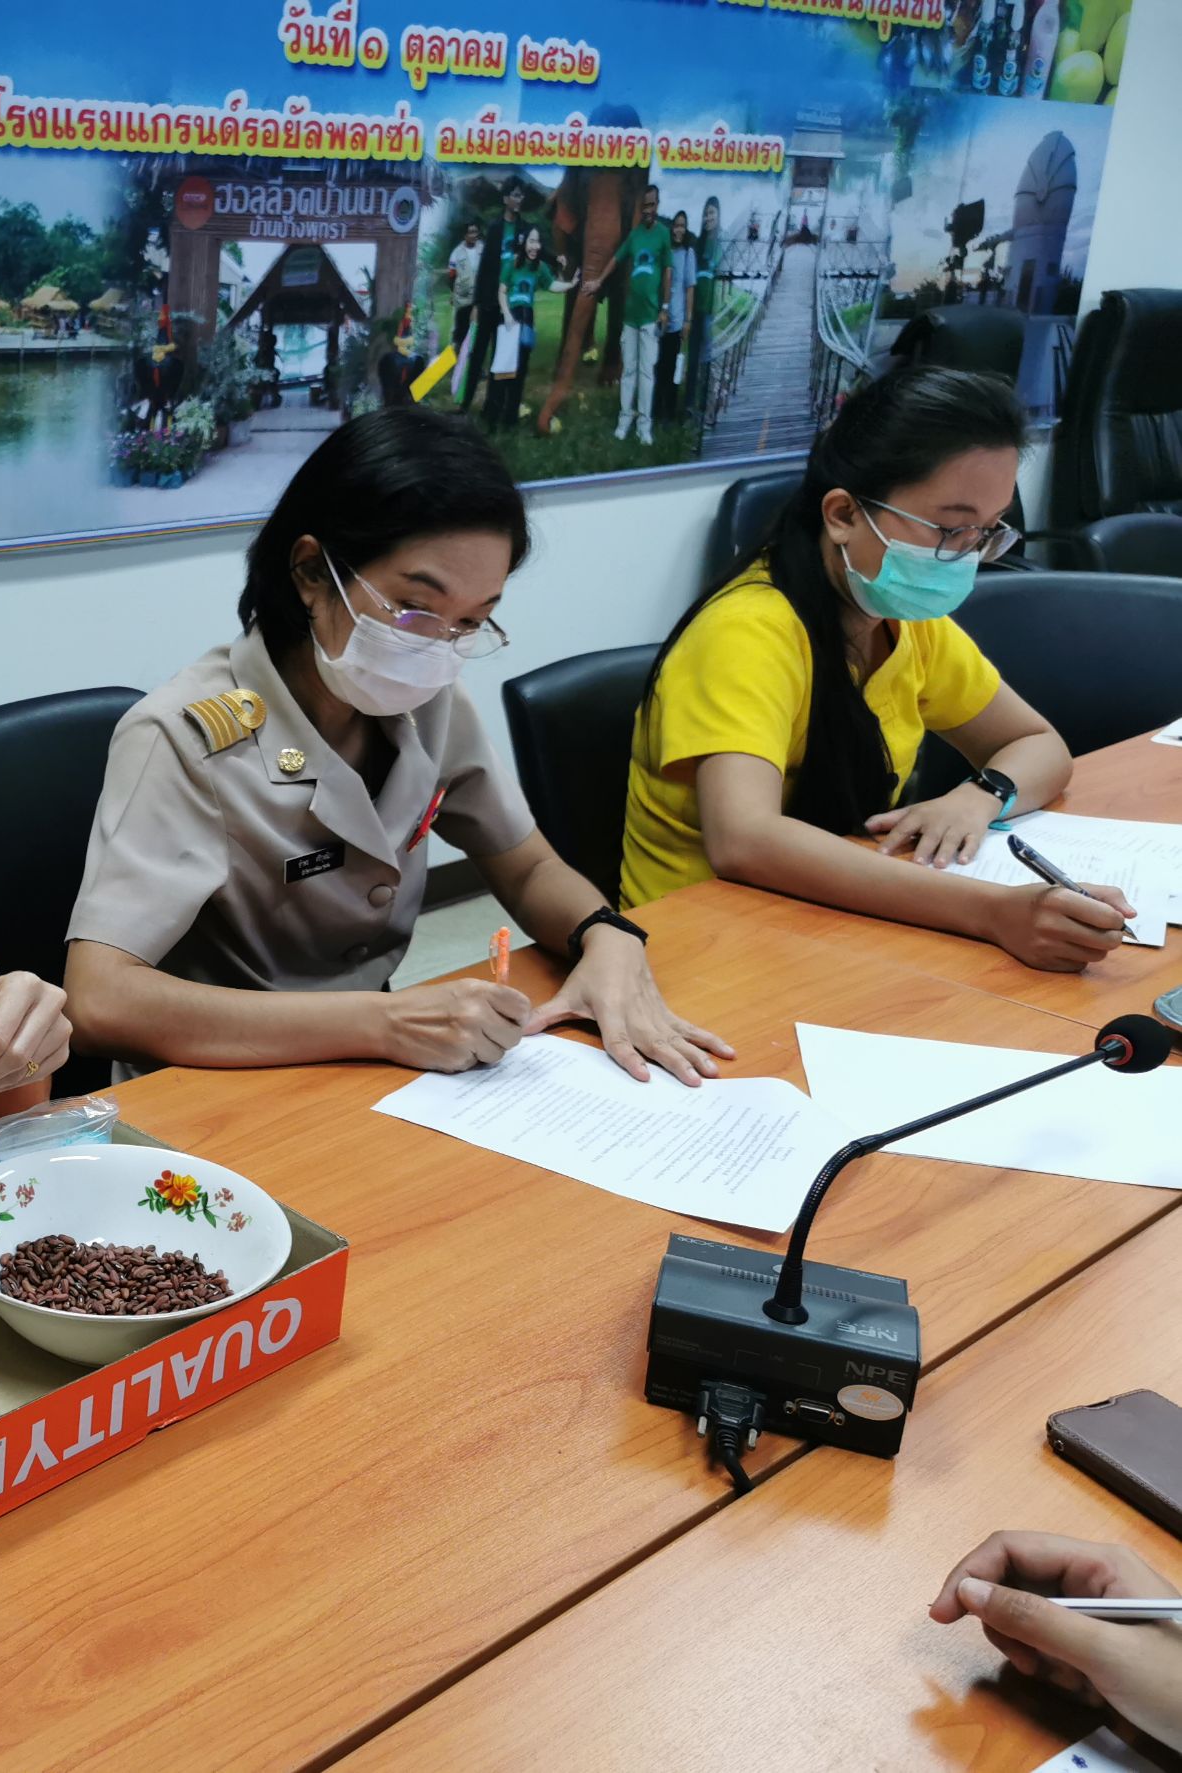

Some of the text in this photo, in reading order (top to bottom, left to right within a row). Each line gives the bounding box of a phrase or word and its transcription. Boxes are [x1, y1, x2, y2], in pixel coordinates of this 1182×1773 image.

[284, 0, 596, 82] วันที่ ๑ ตุลาคม ๒๕๖๒
[439, 112, 649, 161] อ.เมืองฉะเชิงเทรา
[656, 127, 782, 167] จ.ฉะเชิงเทรา
[836, 1320, 899, 1342] NPE
[11, 1296, 302, 1488] QUALITY
[845, 1359, 909, 1386] NPE
